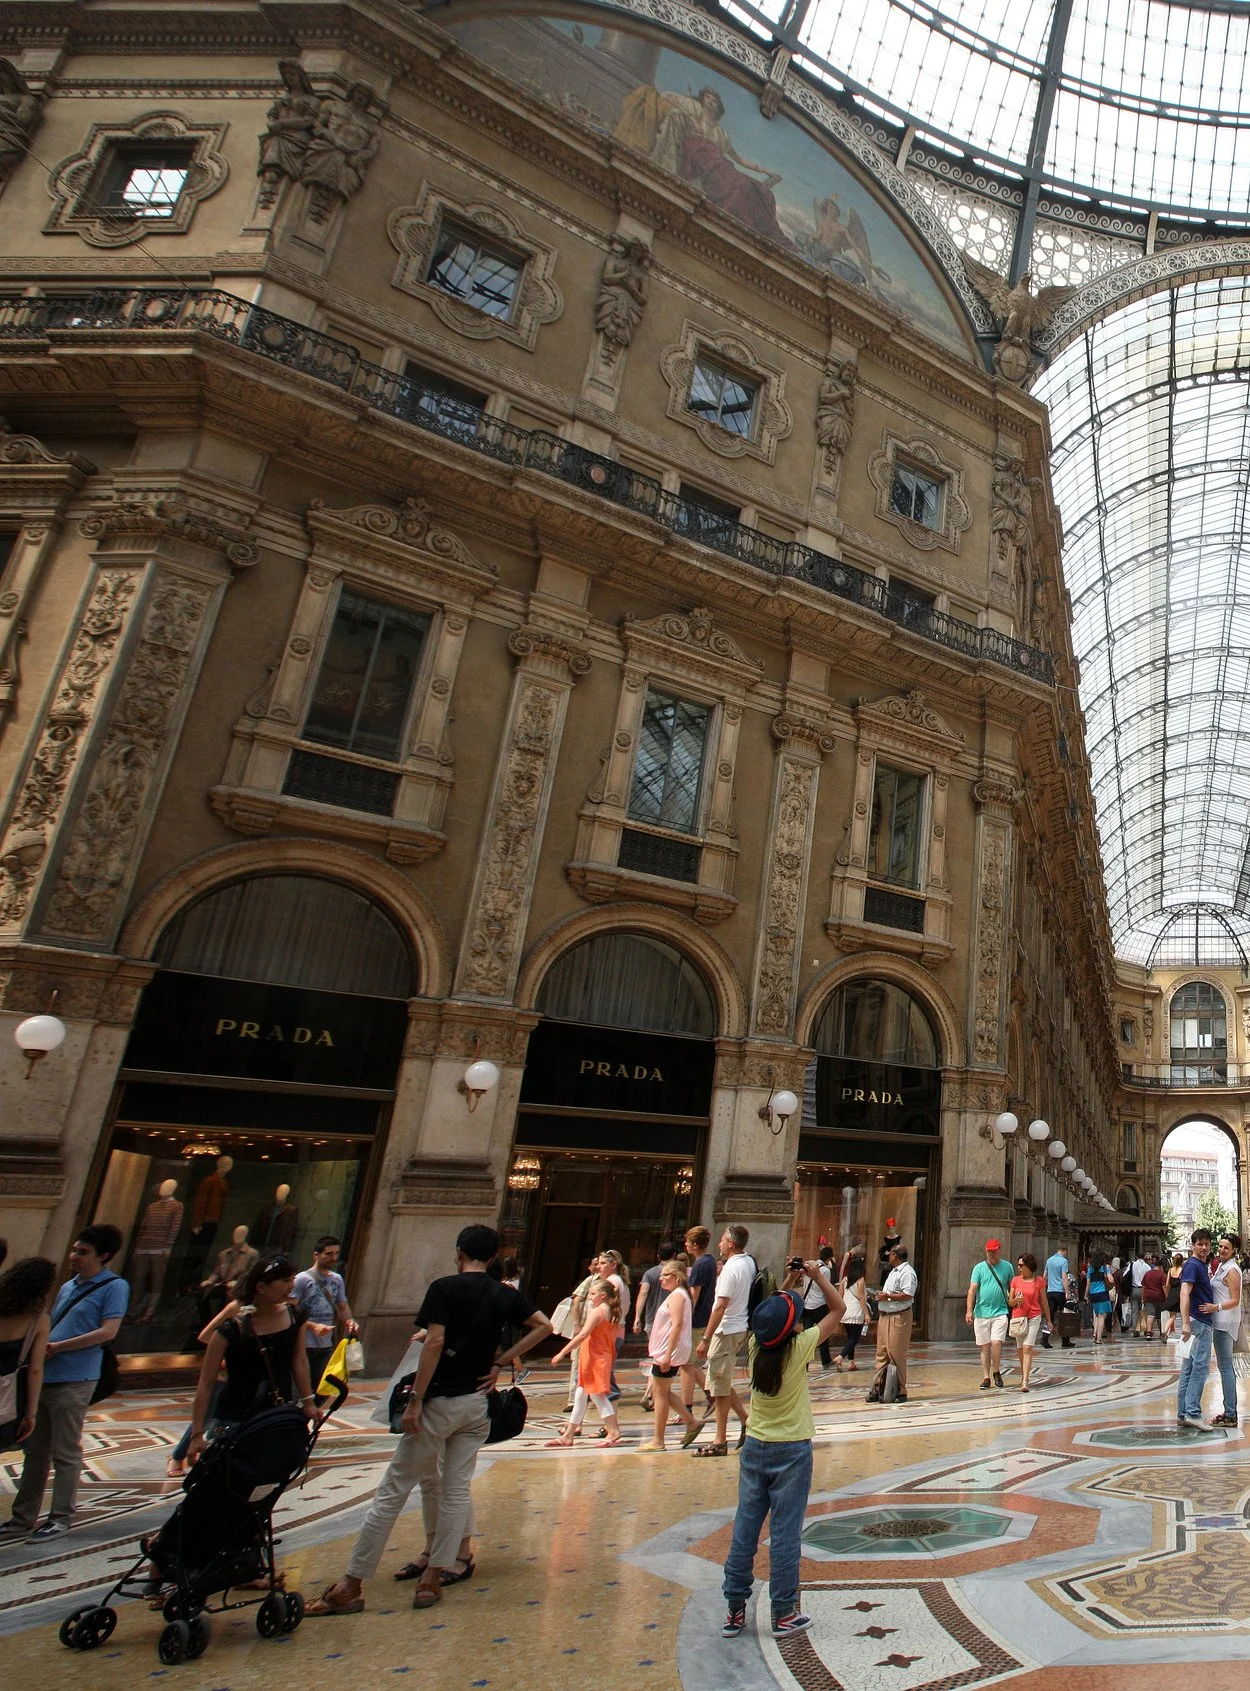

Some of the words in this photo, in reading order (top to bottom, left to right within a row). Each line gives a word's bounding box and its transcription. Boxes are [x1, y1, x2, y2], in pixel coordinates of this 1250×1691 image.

[215, 1018, 336, 1047] PRADA
[580, 1060, 664, 1082] PRADA
[841, 1088, 904, 1105] PRADA
